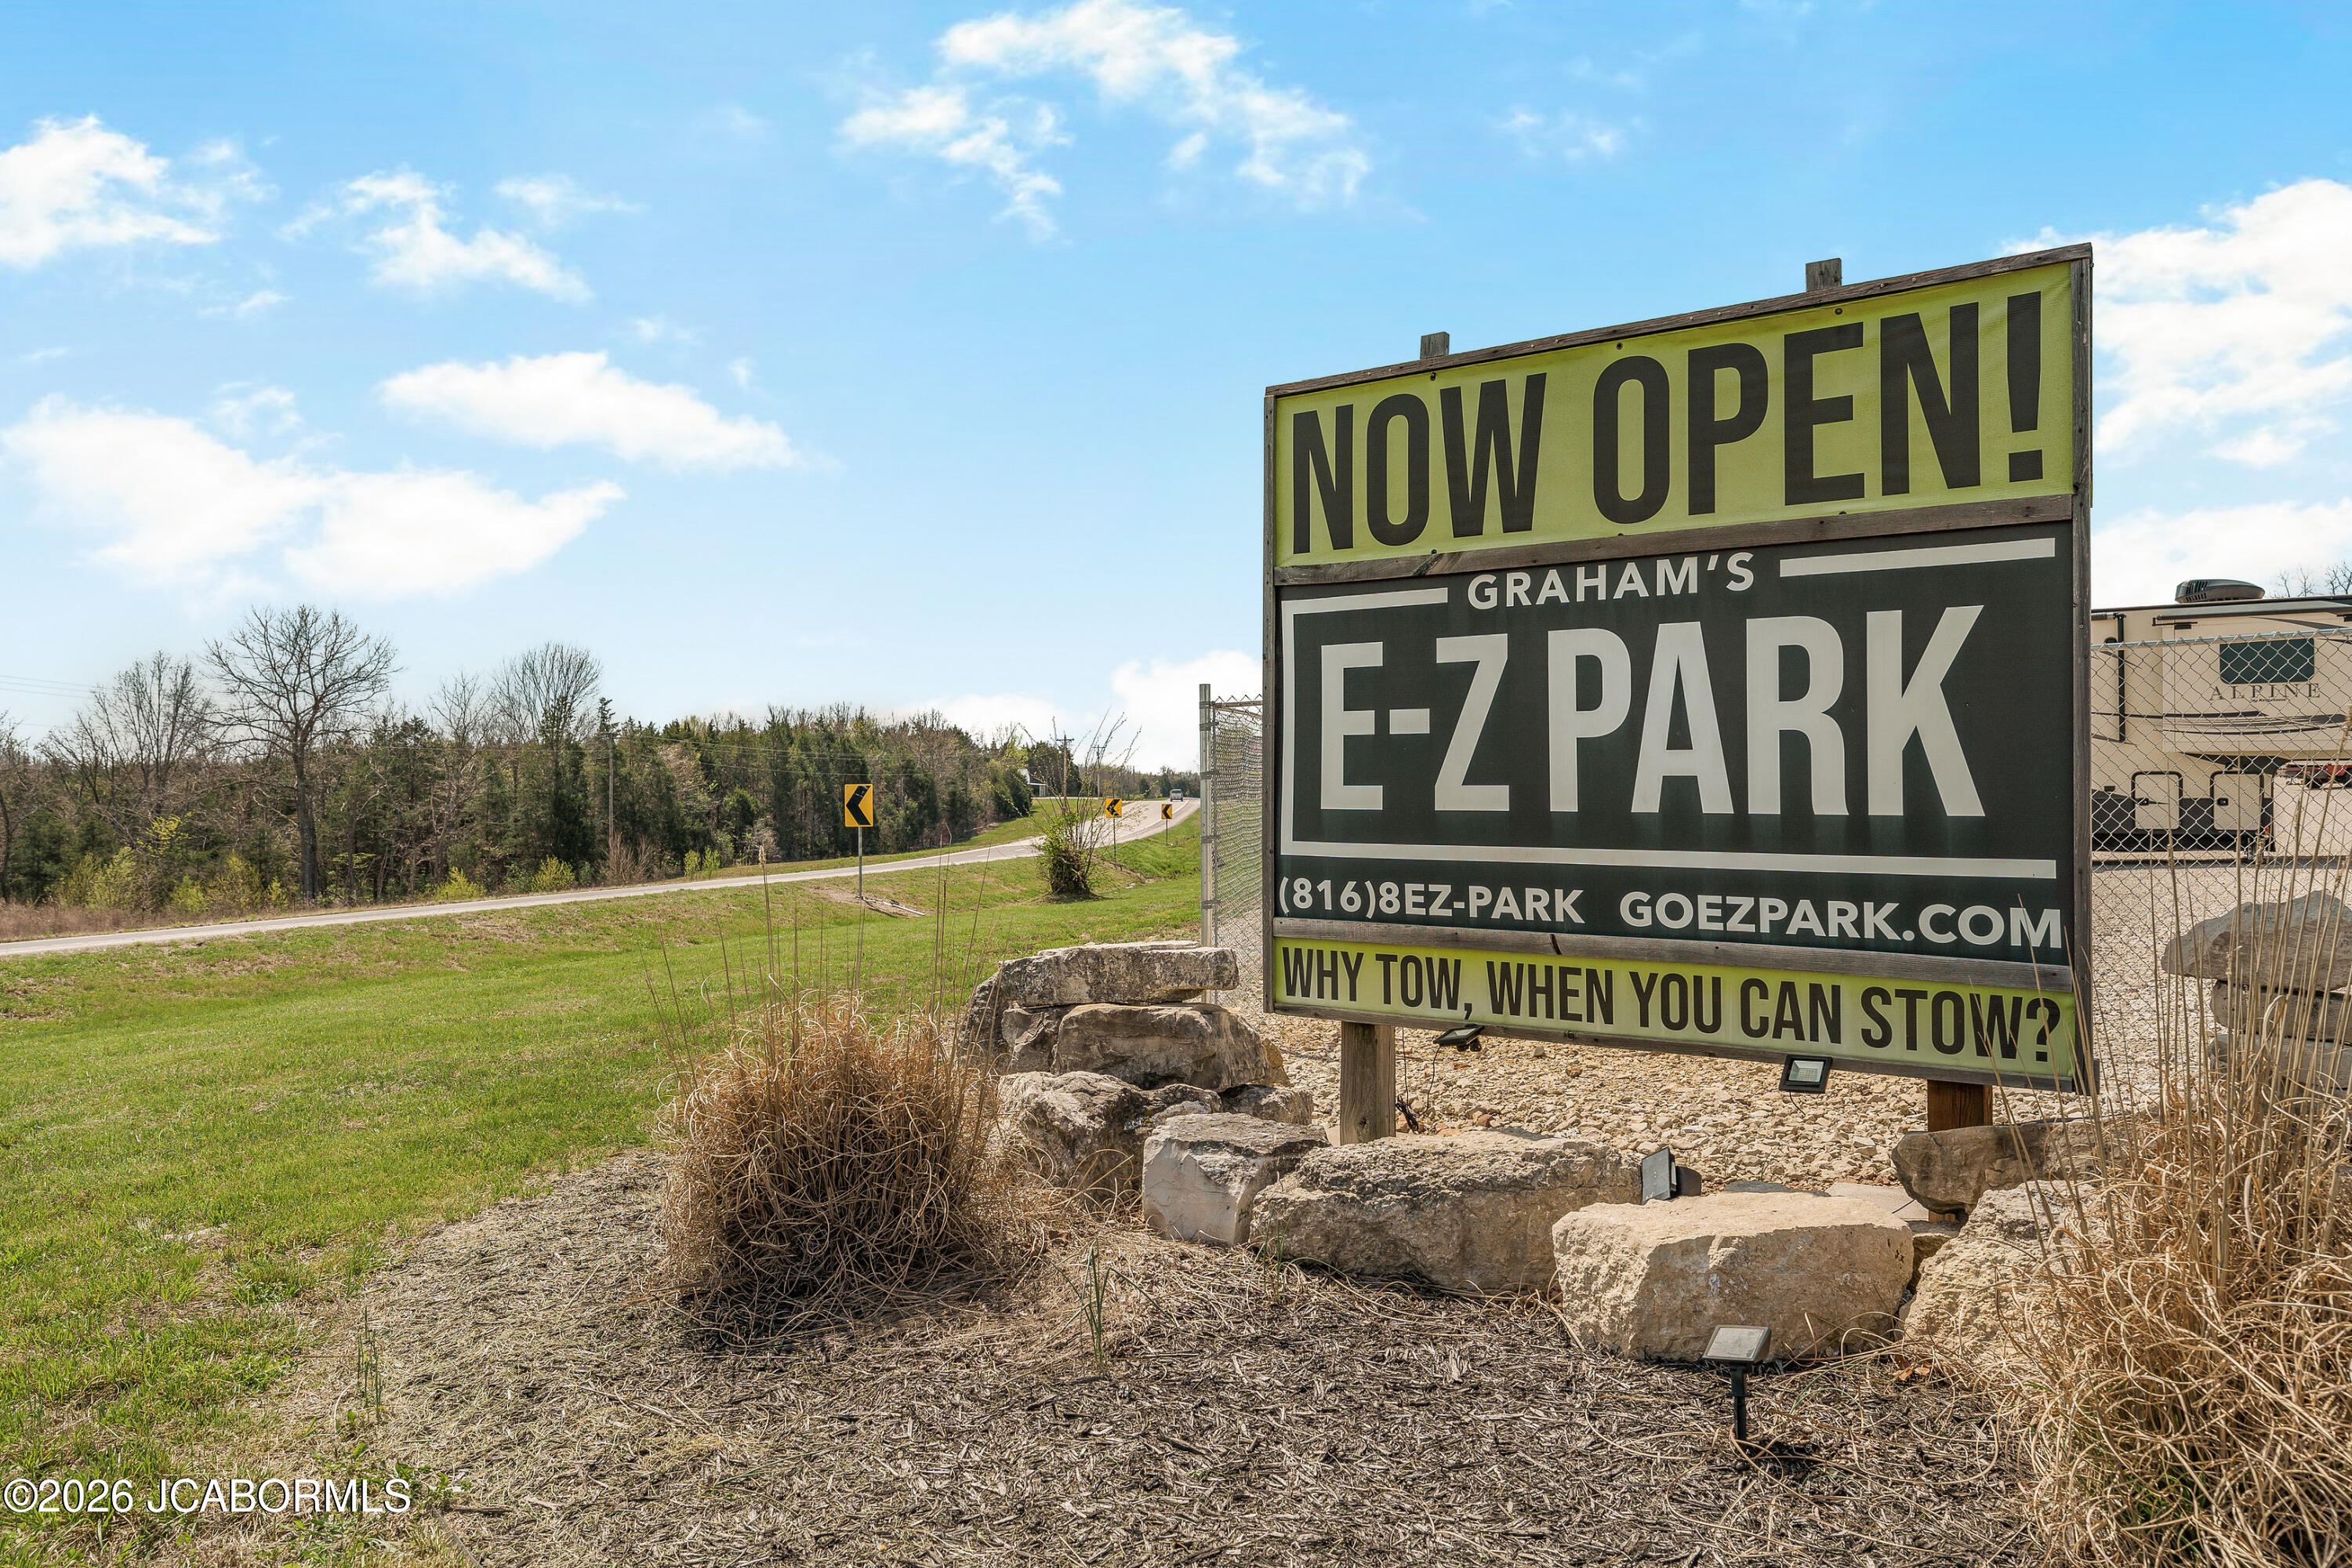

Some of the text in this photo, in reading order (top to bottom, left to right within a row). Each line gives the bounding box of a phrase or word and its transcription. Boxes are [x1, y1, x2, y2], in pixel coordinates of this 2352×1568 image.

[1292, 290, 2043, 554] NOW OPEN!
[1320, 604, 1986, 817] E-Z PARK
[2209, 683, 2321, 701] ALPINE
[1279, 877, 2061, 949] (816)8EZ-PARK GOEZPARK.COM
[1282, 946, 2061, 1062] WHY TOW, WHEN YOU CAN STOW?
